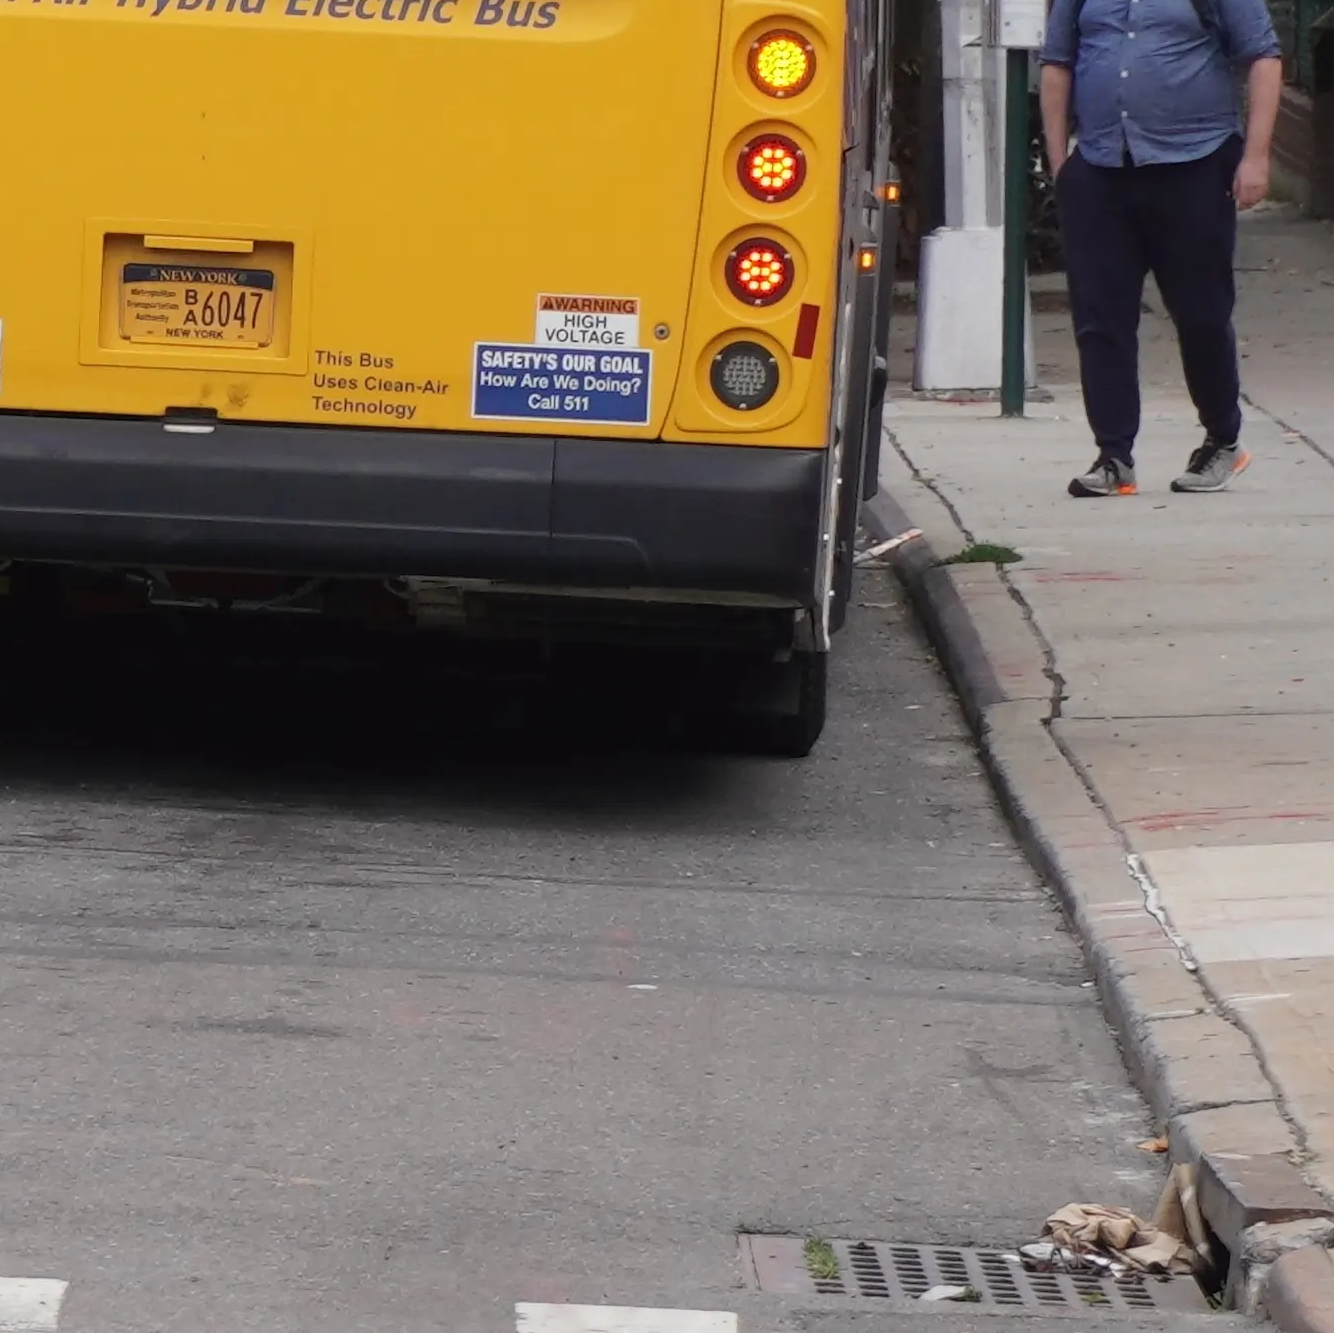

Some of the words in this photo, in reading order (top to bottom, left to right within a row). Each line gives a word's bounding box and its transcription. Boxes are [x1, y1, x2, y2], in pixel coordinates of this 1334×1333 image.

[160, 270, 195, 283] NEW
[197, 271, 237, 284] YORK
[555, 298, 635, 313] WARNING
[564, 314, 607, 328] HIGH
[166, 328, 191, 338] NEW
[194, 329, 223, 339] YORK
[545, 328, 625, 345] VOLTAGE
[315, 350, 352, 366] This
[360, 353, 394, 369] Bus
[481, 350, 558, 371] SAFETY'S
[562, 354, 596, 373] OUR
[600, 356, 643, 374] GOAL
[313, 373, 358, 390] Uses
[364, 376, 449, 394] Clean-Air
[480, 371, 517, 387] How
[520, 373, 549, 389] Are
[553, 375, 579, 390] We
[584, 376, 641, 396] Doing?
[312, 396, 417, 420] Technology
[528, 394, 559, 410] Call
[564, 396, 589, 411] 511
